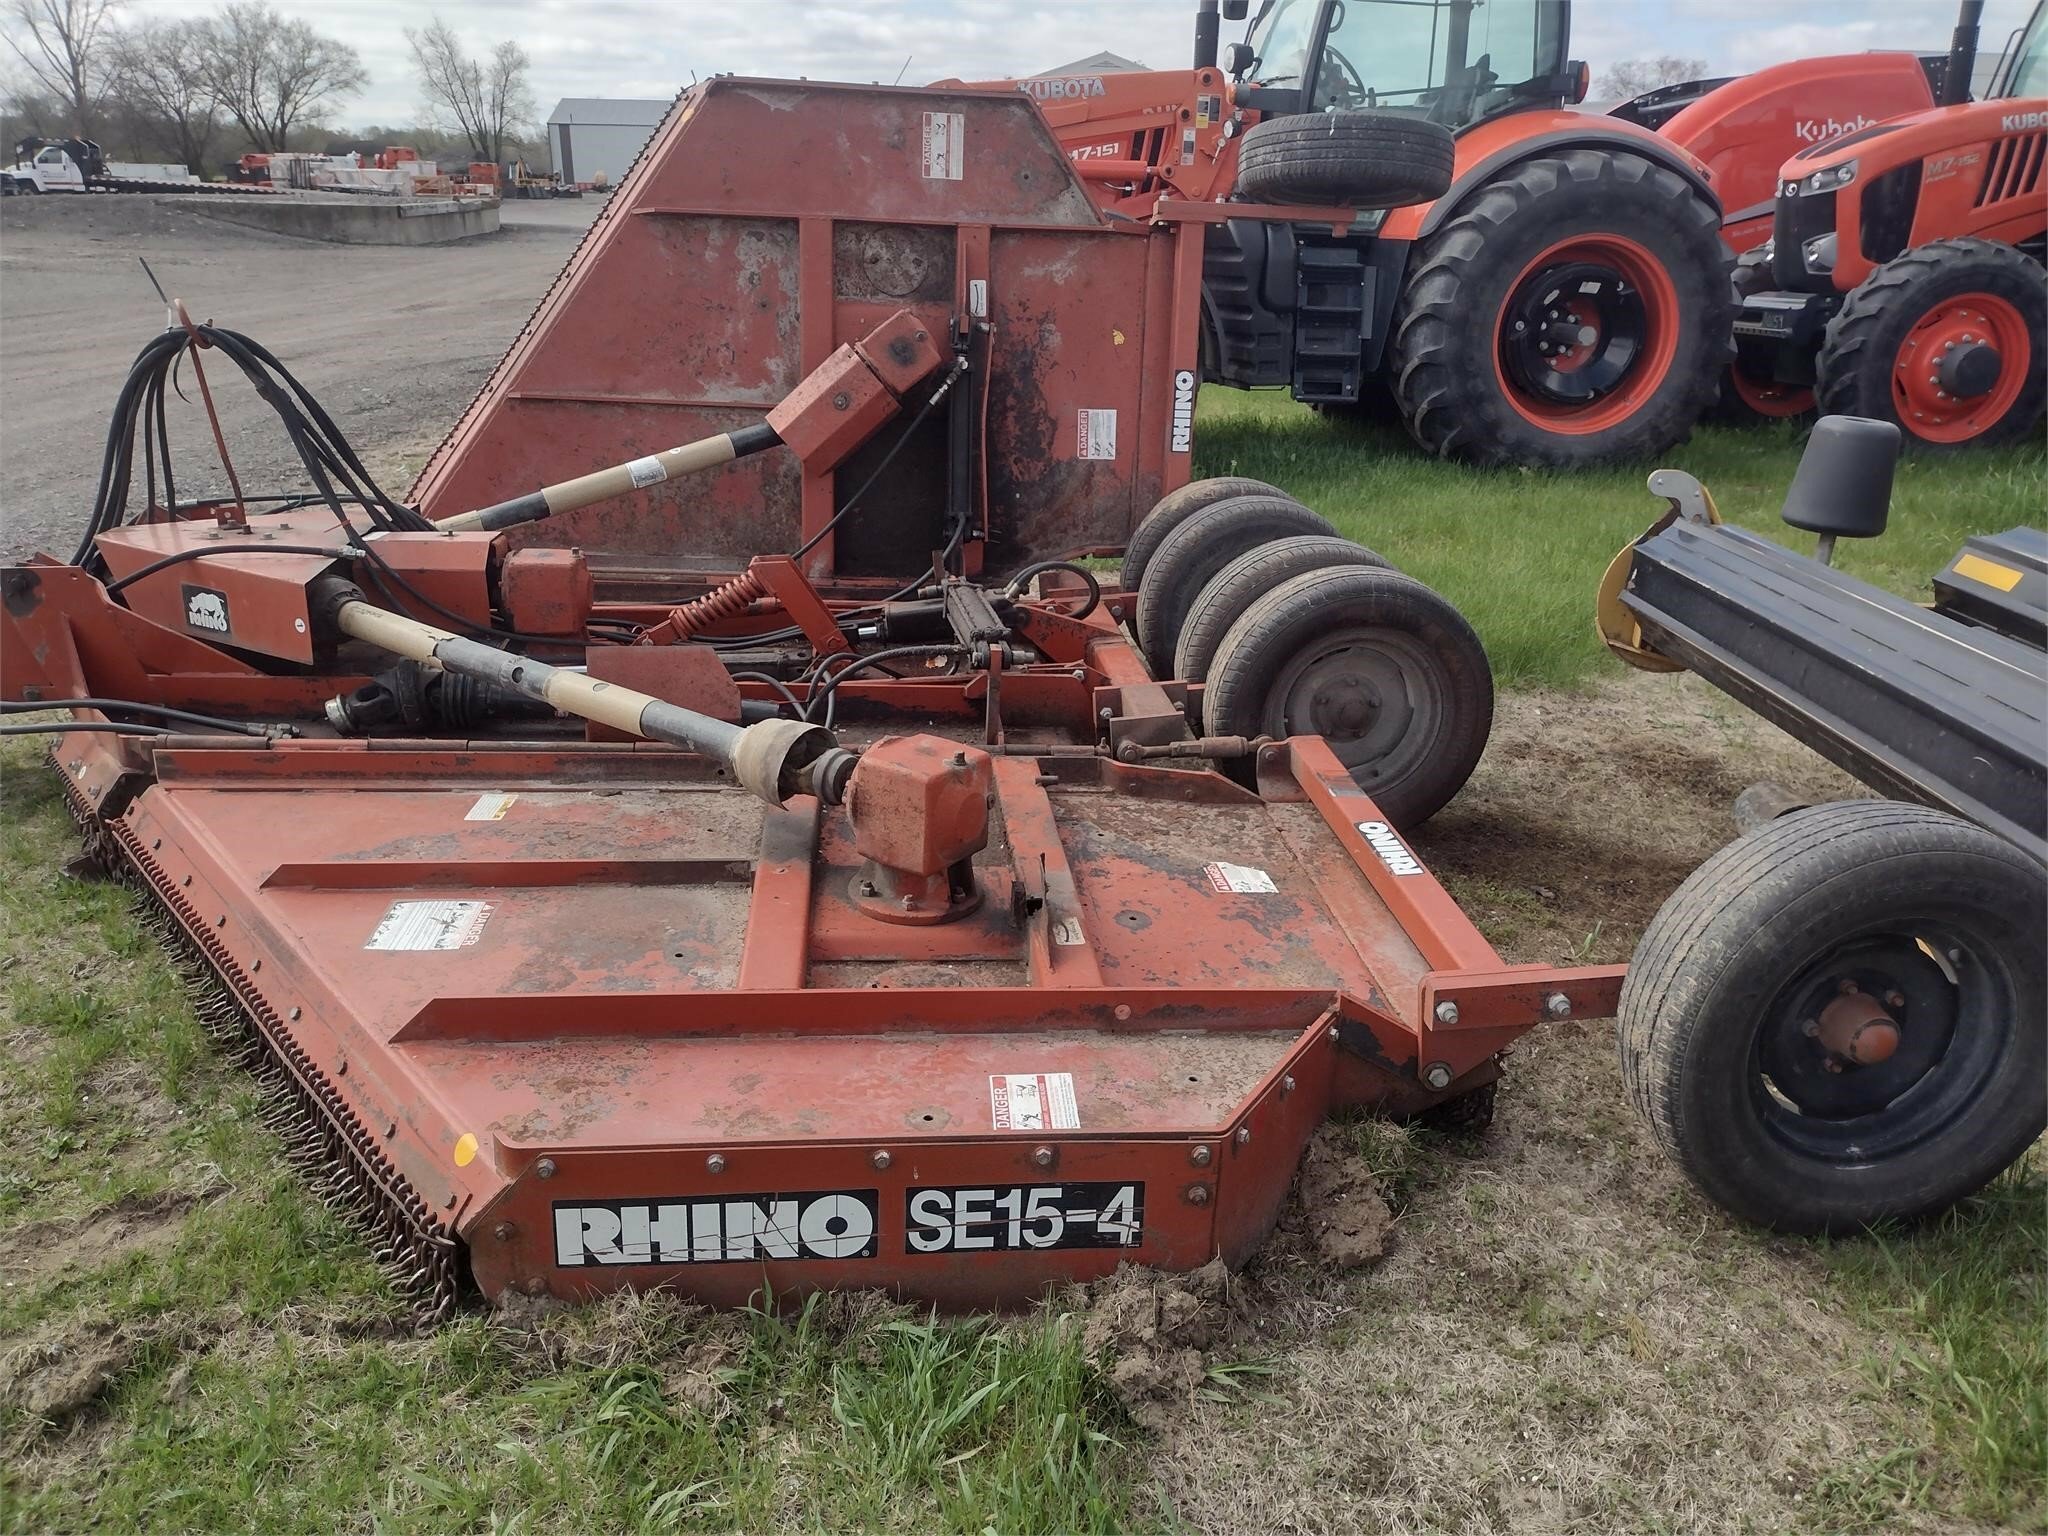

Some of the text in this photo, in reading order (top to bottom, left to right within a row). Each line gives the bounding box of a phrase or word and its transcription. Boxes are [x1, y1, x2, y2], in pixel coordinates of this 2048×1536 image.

[1018, 77, 1106, 99] KUBOTA
[924, 126, 932, 165] DANGER
[1079, 411, 1088, 449] DANGER
[1172, 370, 1194, 452] RHINO
[1358, 821, 1424, 876] RHINO
[461, 912, 491, 946] DANGER
[994, 1087, 1010, 1128] DANGER
[554, 1185, 1141, 1265] RHINO SE15-4
